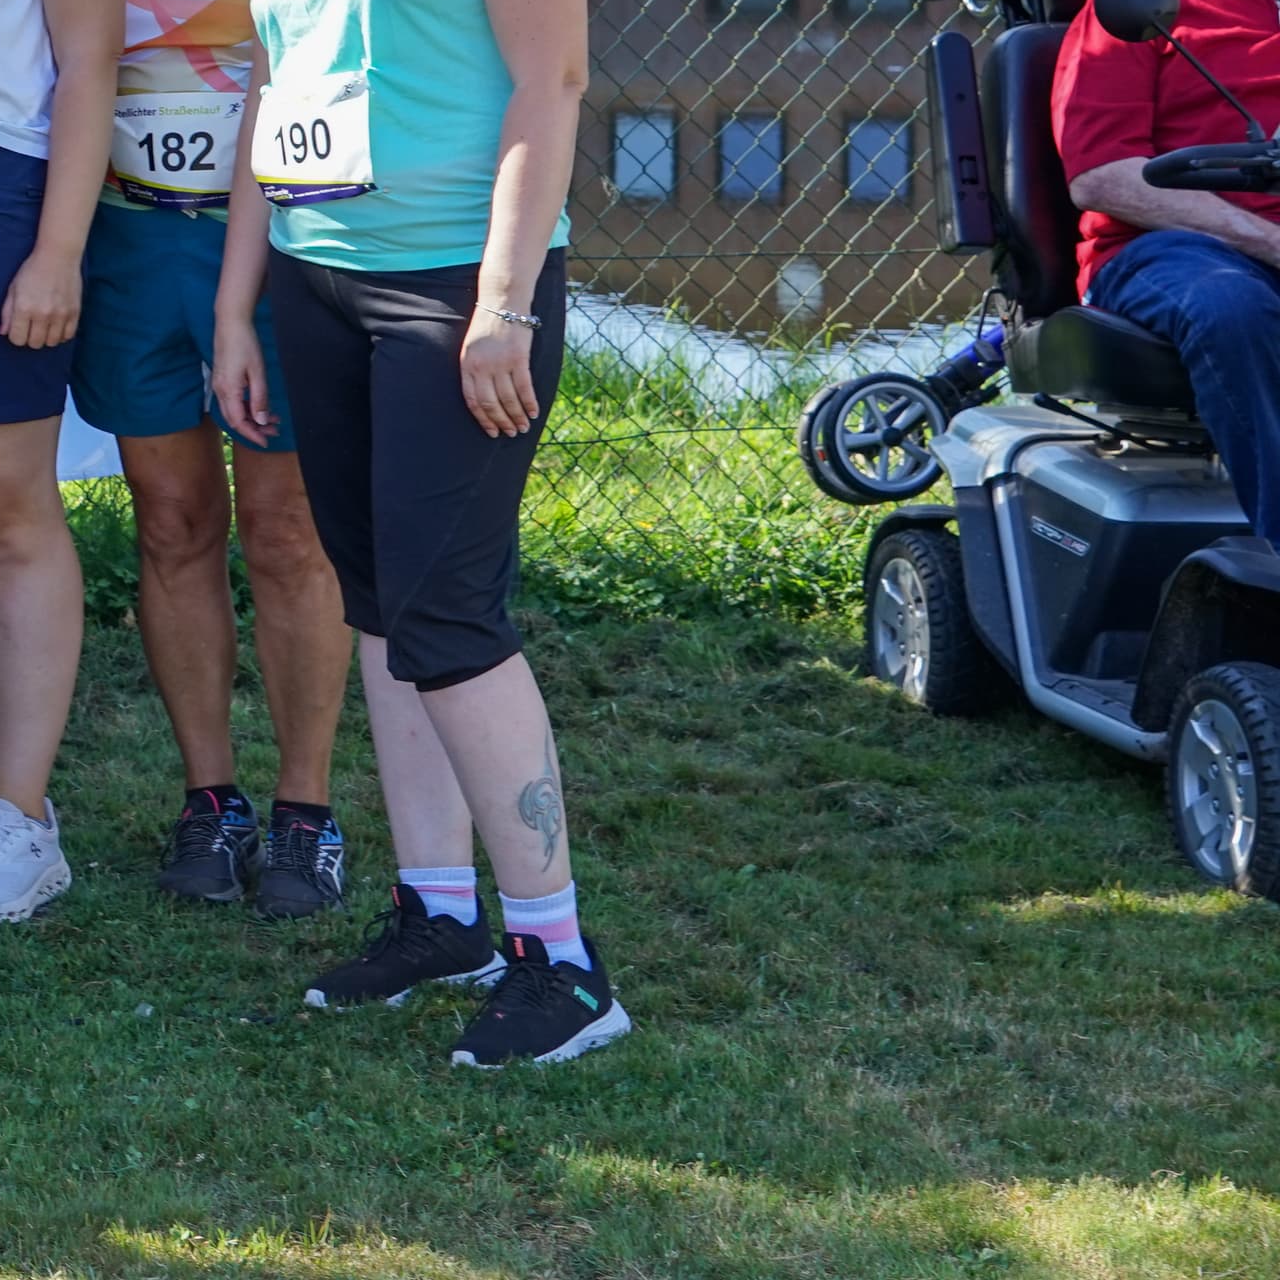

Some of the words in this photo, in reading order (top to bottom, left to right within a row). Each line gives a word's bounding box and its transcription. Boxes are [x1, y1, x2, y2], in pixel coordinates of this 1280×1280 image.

[159, 105, 220, 116] Straßenlauf
[138, 131, 216, 172] 182
[275, 118, 332, 166] 190
